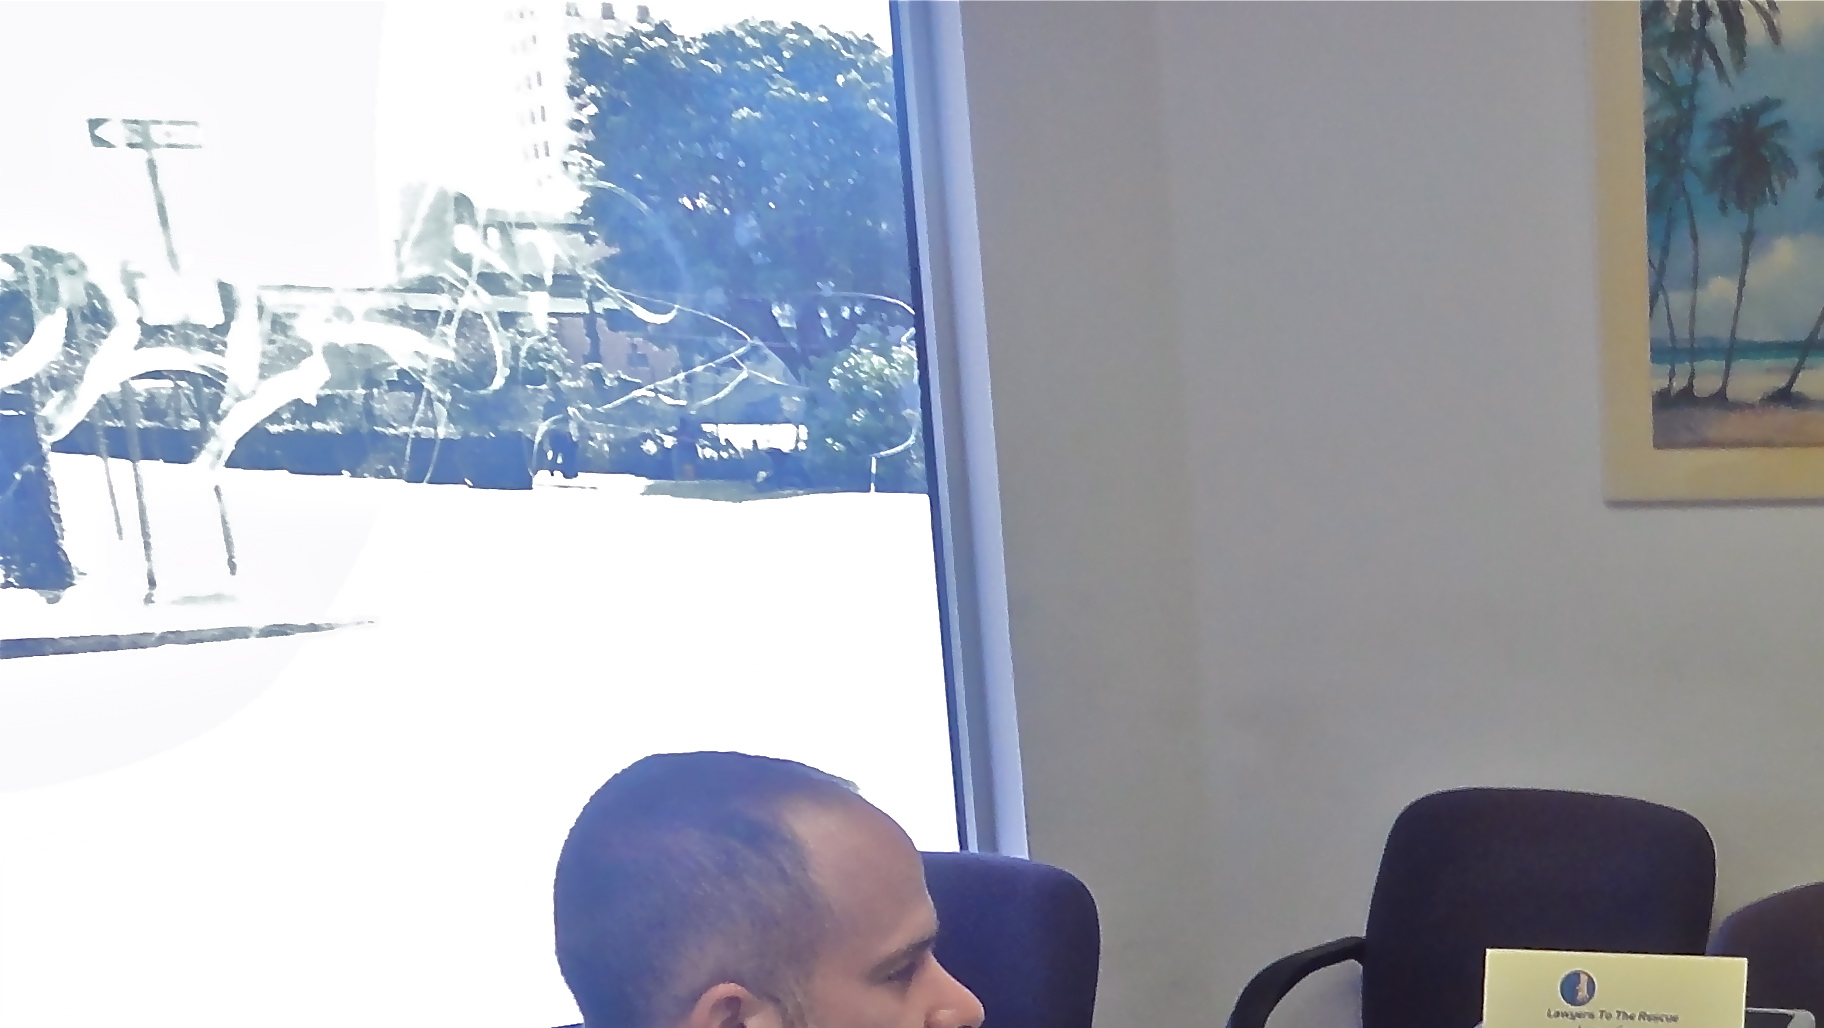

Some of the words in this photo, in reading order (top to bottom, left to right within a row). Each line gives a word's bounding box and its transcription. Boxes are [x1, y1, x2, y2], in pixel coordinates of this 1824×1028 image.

[1546, 1008, 1596, 1021] Lawyers
[1599, 1009, 1613, 1021] To
[1615, 1009, 1636, 1021] The
[1637, 1010, 1680, 1023] Rescue
